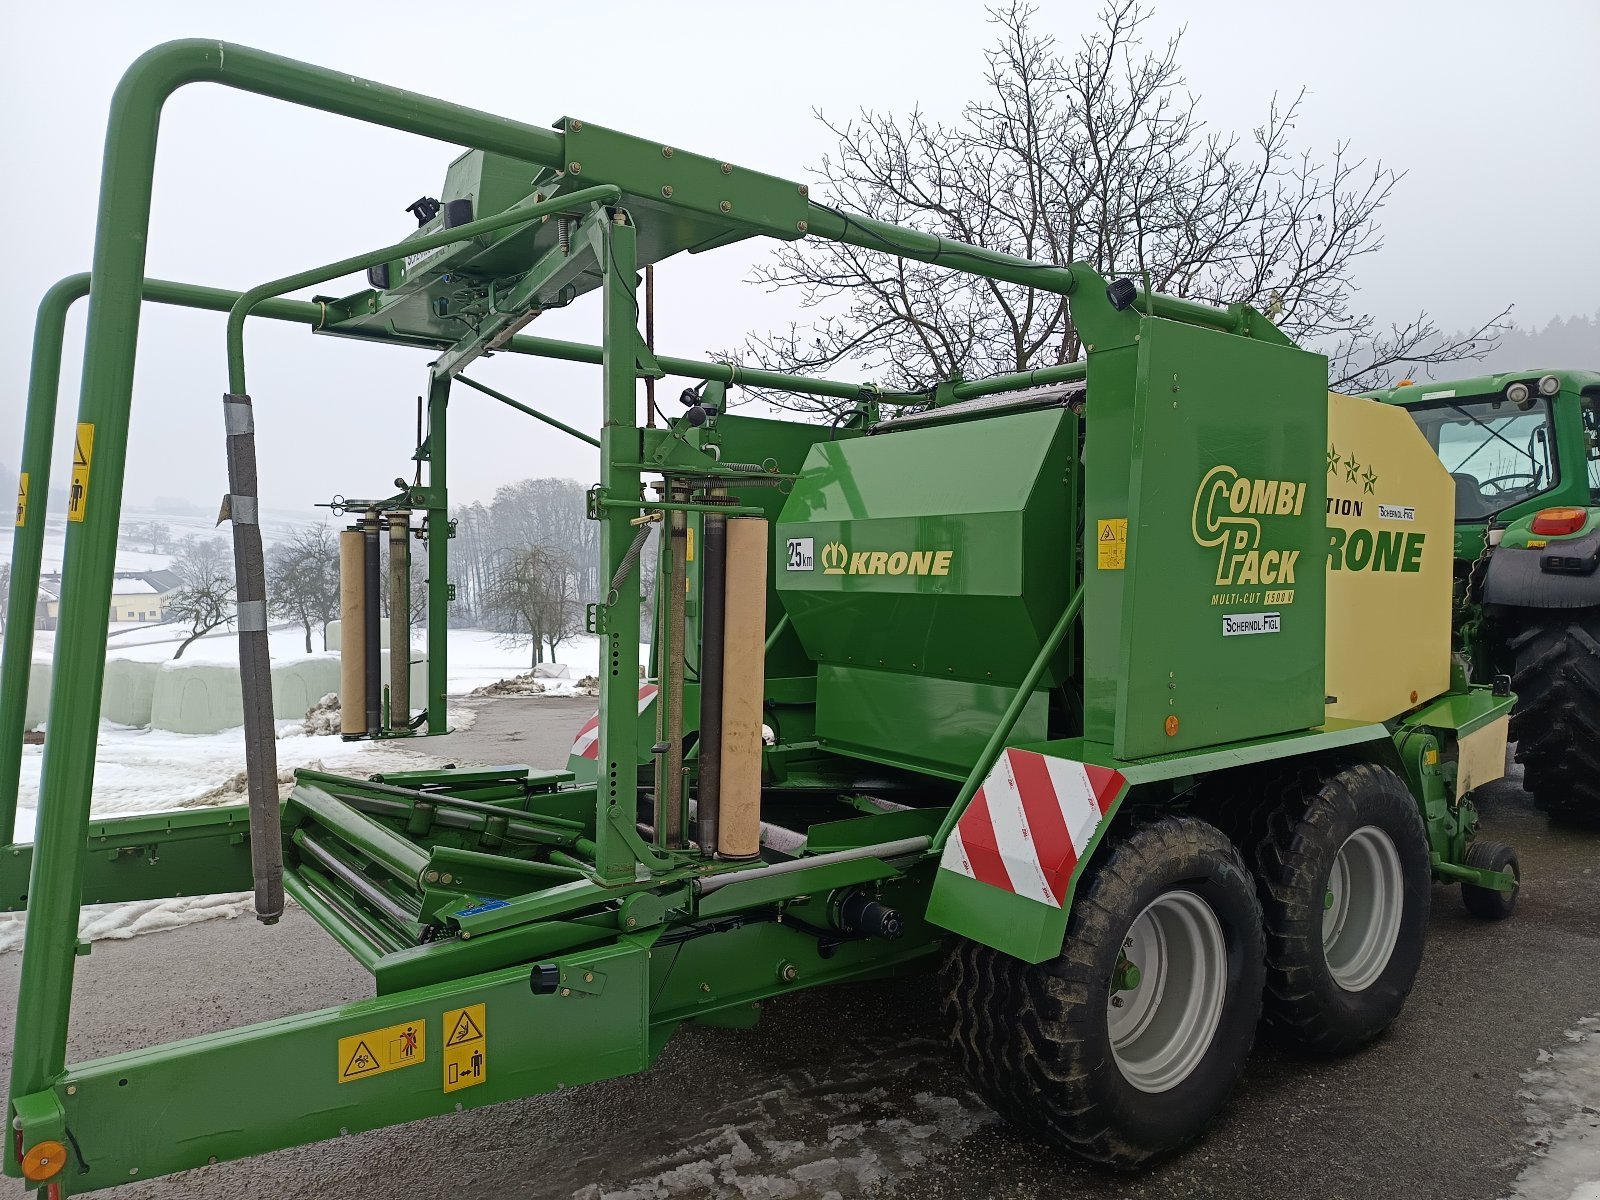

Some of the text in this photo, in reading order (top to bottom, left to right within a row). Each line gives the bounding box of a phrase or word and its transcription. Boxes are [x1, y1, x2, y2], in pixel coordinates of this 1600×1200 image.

[1191, 464, 1307, 547] COMBI
[1326, 498, 1363, 516] TION
[787, 542, 813, 567] 25 km
[848, 550, 954, 576] KRONE
[1215, 516, 1300, 586] PACK
[1326, 527, 1426, 573] RONE
[1211, 592, 1261, 606] MULTI-CUT
